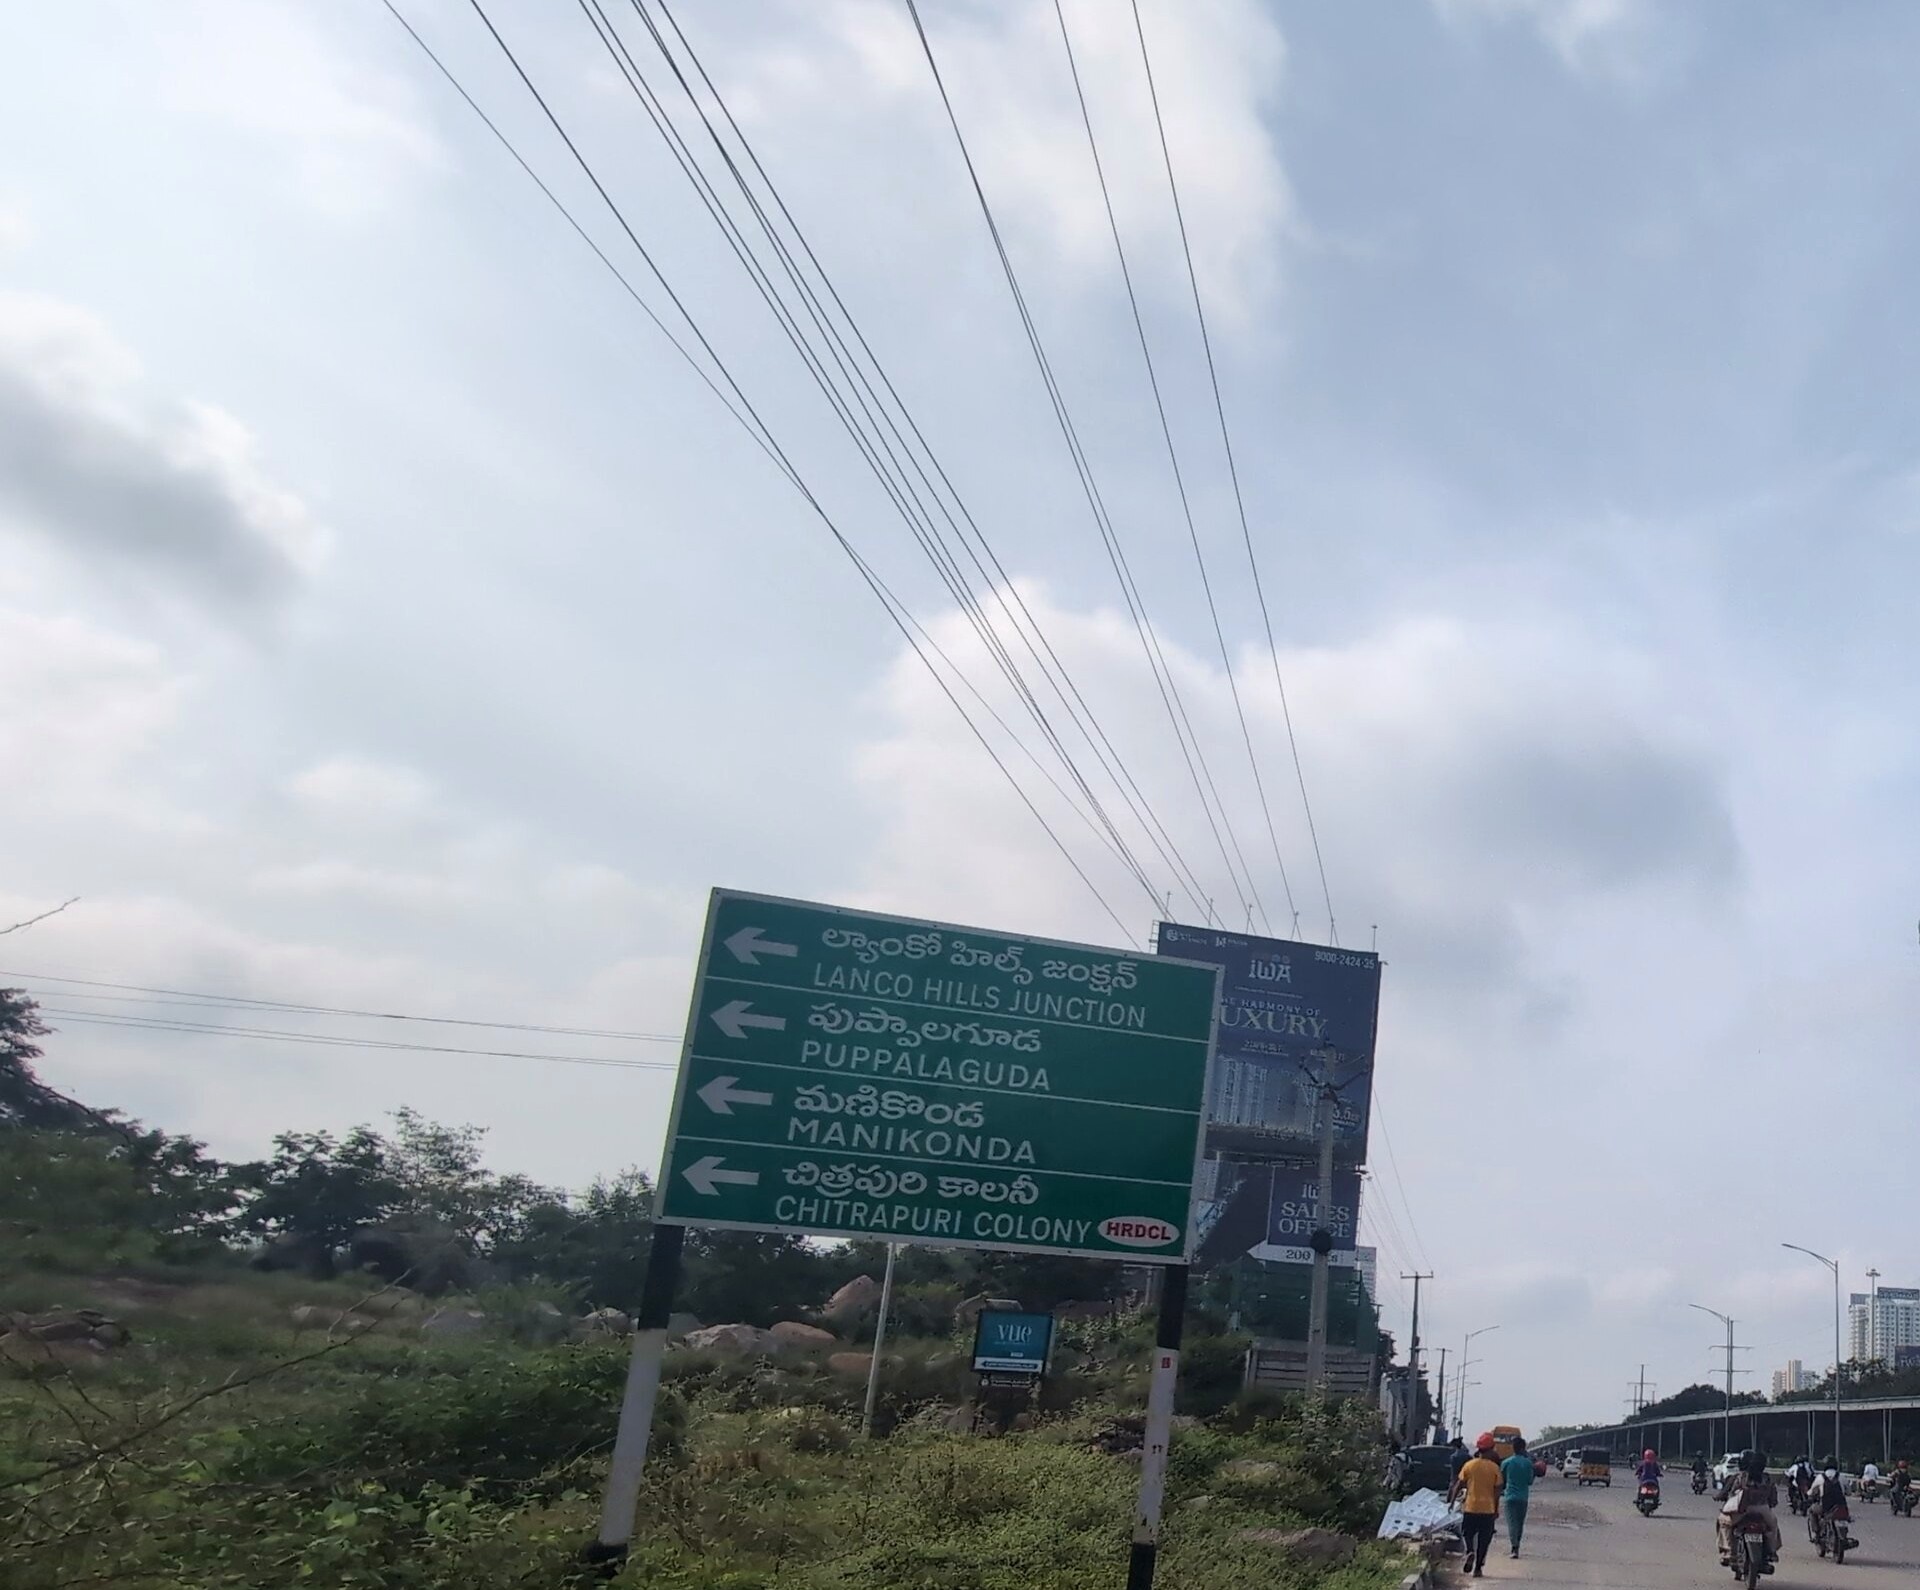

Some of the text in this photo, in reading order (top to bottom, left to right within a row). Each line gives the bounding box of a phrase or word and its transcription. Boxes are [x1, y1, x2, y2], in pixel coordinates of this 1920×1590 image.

[813, 963, 1145, 1029] LANCO HILLS JUNCTION
[1241, 999, 1301, 1014] HARMONY
[1306, 1008, 1320, 1017] OF
[1220, 1004, 1328, 1039] UXURY
[801, 1040, 1050, 1091] PUPPALAGUDA
[787, 1116, 1036, 1164] MANIKONDA
[775, 1196, 1172, 1244] CHITRAPURI COLONY HRDCL
